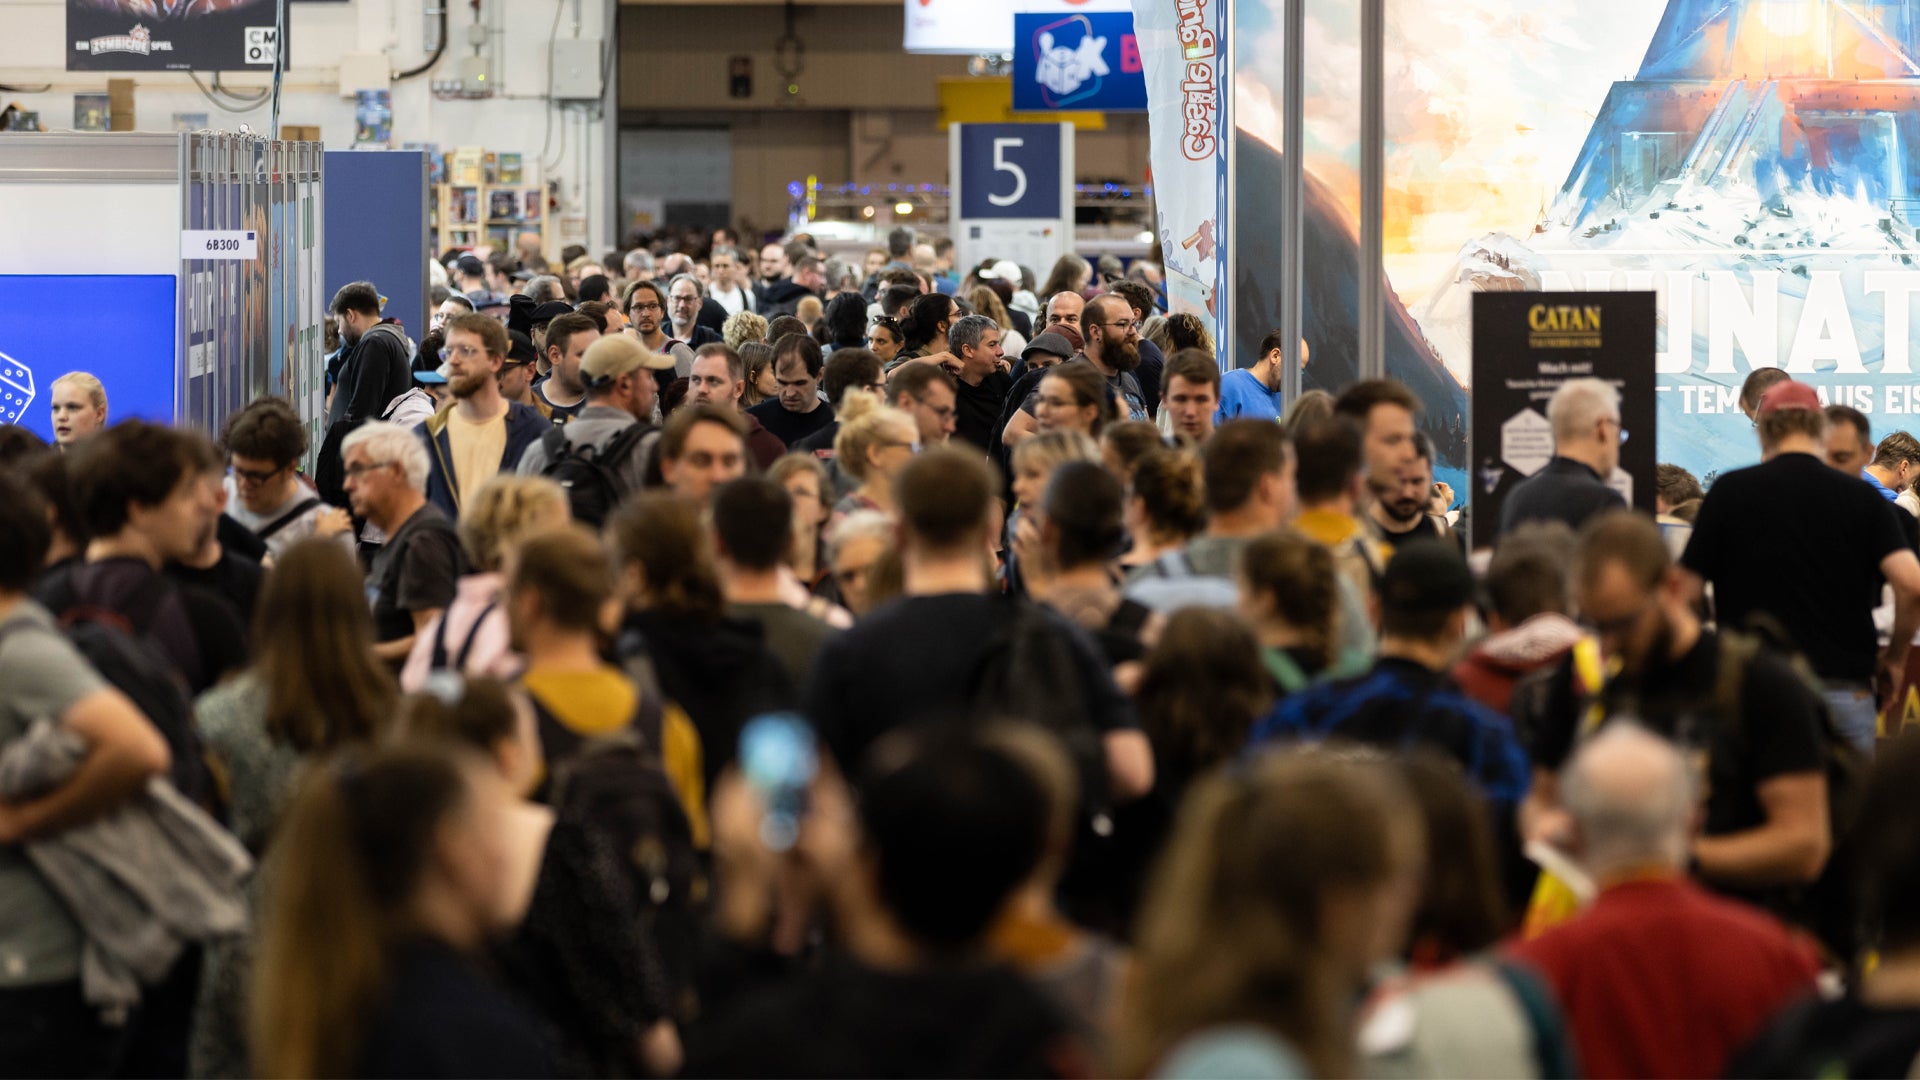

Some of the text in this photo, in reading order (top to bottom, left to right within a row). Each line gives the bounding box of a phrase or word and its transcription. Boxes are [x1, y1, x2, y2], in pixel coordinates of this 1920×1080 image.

[75, 41, 89, 50] EIN
[151, 41, 173, 50] SPIEL
[988, 138, 1028, 207] 5
[206, 239, 240, 251] 6B300
[1528, 304, 1601, 332] CATAN
